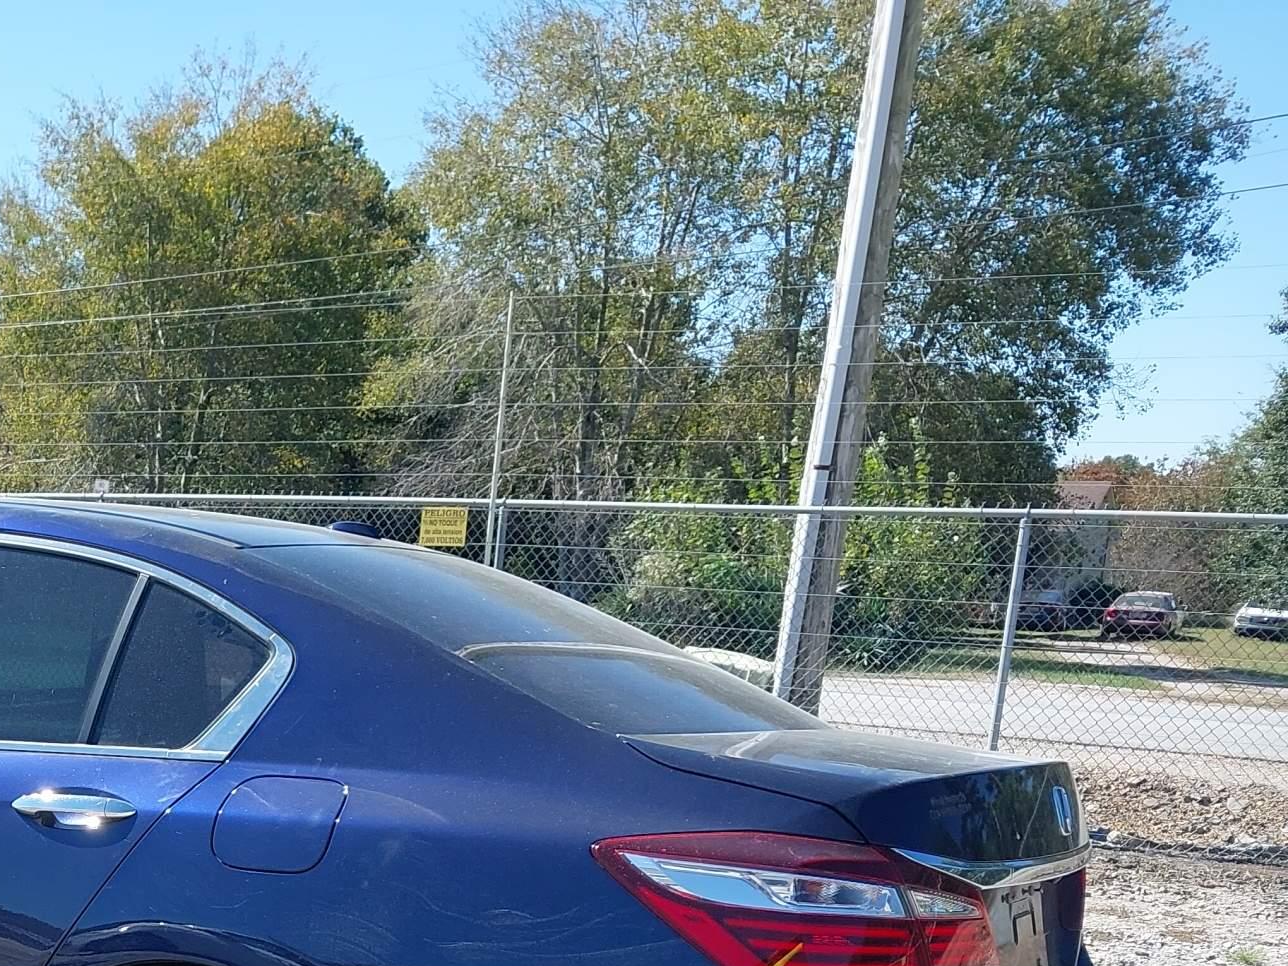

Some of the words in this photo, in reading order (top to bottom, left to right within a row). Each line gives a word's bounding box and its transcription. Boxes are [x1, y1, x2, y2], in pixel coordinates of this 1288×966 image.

[424, 509, 466, 517] PELIGRO
[439, 519, 458, 527] TOQUE
[437, 536, 463, 544] VOLTIOS
